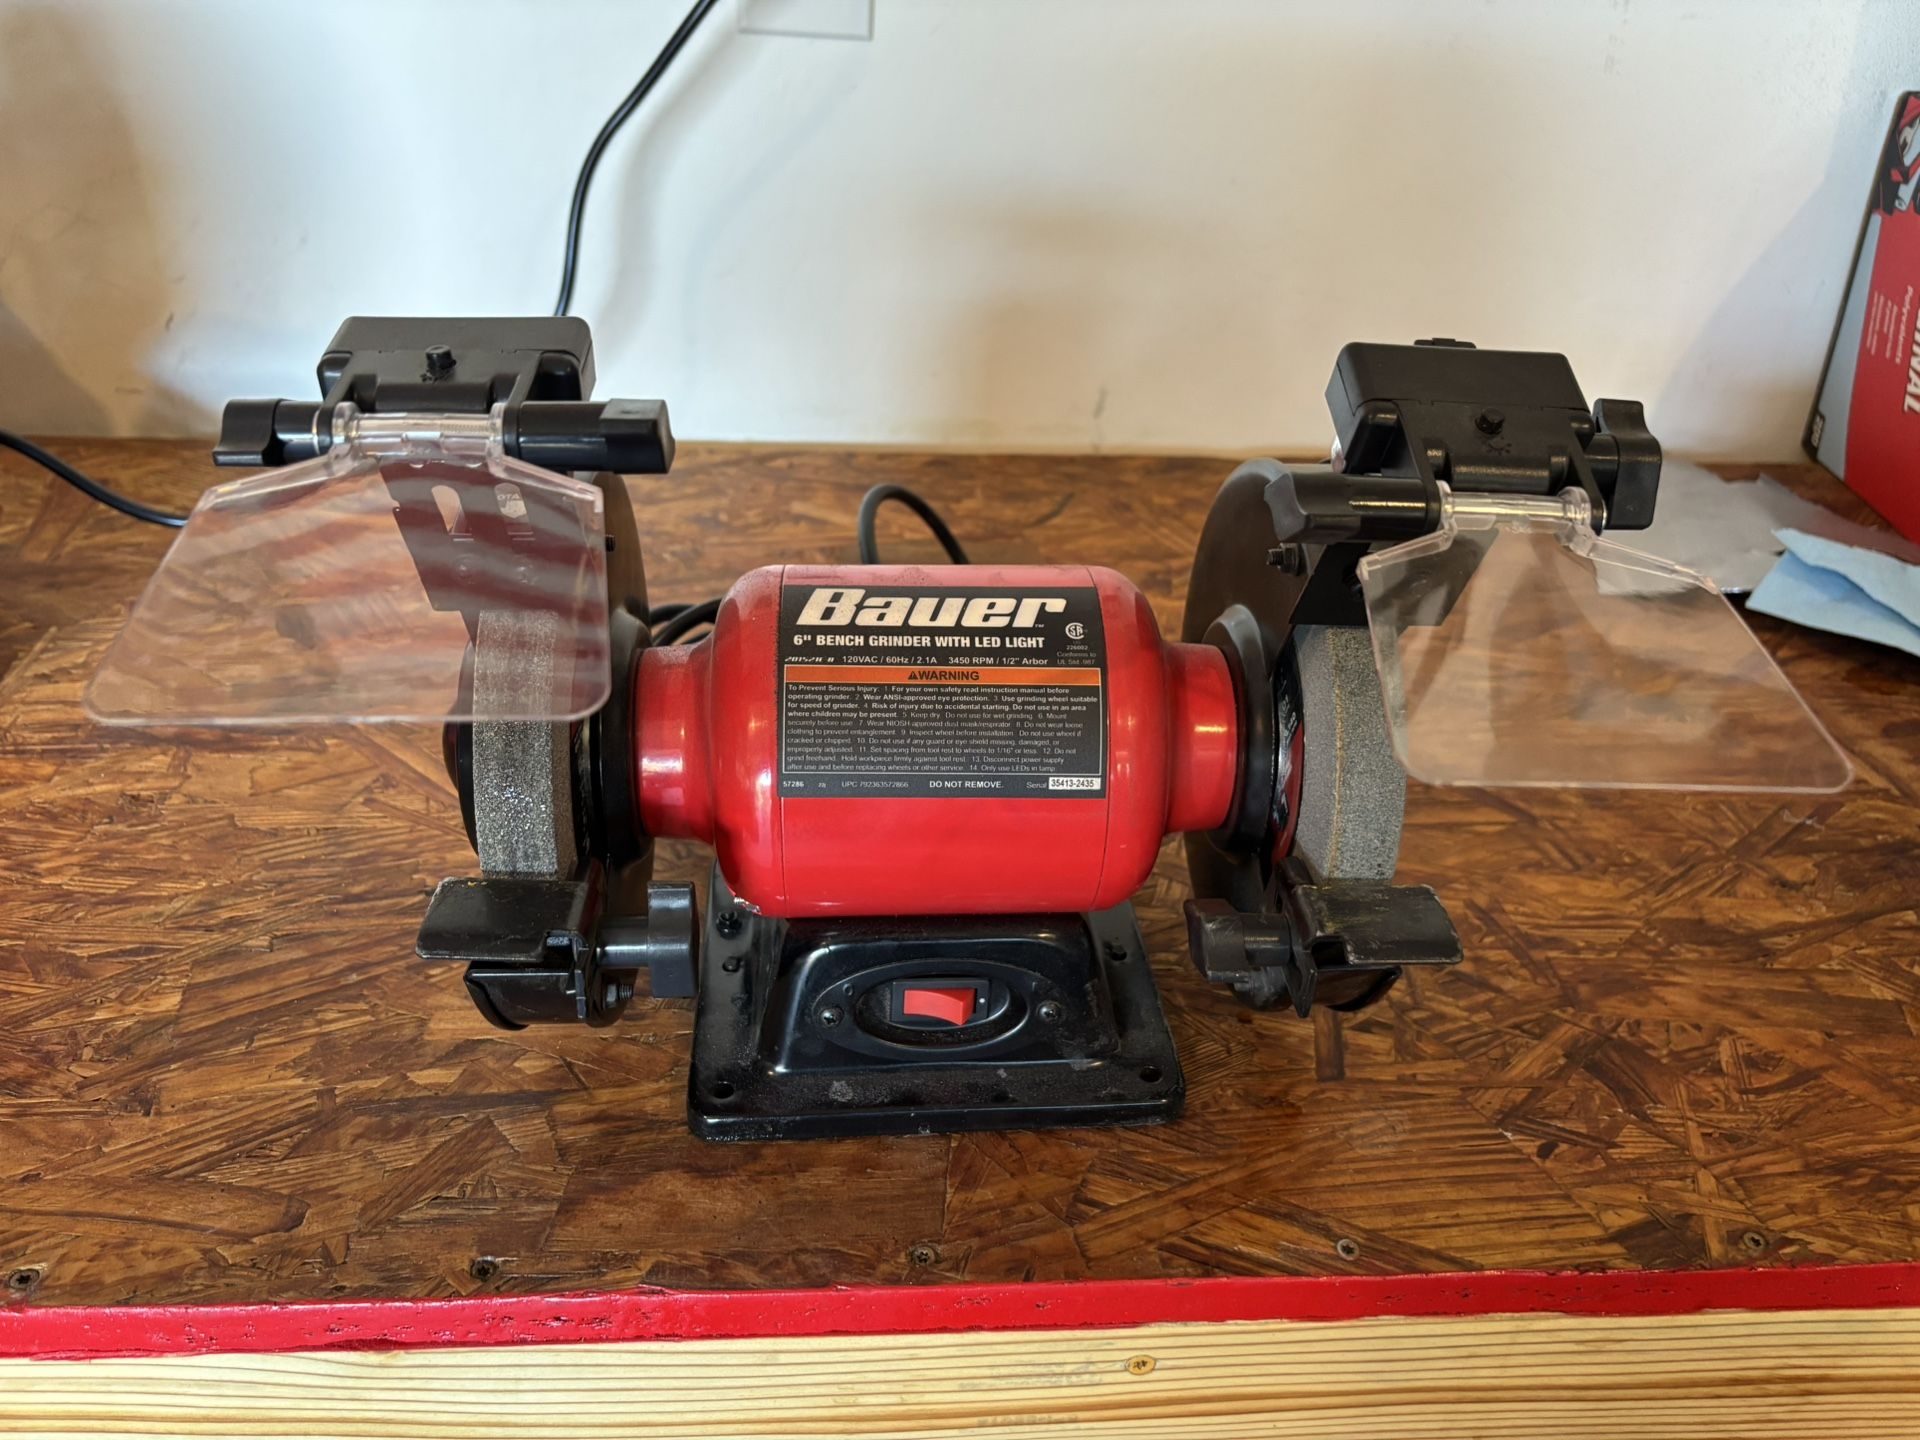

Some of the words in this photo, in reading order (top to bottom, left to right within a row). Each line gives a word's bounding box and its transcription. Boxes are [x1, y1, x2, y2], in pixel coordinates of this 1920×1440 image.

[796, 588, 1067, 628] Bauer
[793, 634, 811, 646] 6"
[816, 635, 865, 647] BENCH
[868, 635, 931, 647] GRINDER
[934, 636, 971, 647] WITH
[974, 636, 1001, 648] LED
[1005, 636, 1045, 648] LIGHT
[842, 655, 878, 663] 120VAC
[886, 656, 909, 664] 60Hz
[917, 656, 937, 664] 2.1A
[948, 656, 970, 665] 3450
[972, 656, 994, 665] RPM
[1022, 657, 1048, 665] Arbor
[919, 671, 980, 681] WARNING
[941, 686, 961, 694] safety
[788, 693, 822, 701] operating
[883, 694, 936, 702] ANSI-approved
[1017, 695, 1046, 703] grinding
[800, 702, 821, 710] speed
[899, 702, 919, 710] injury
[929, 780, 942, 788] DO
[965, 781, 1004, 789] REMOVE.
[1051, 779, 1094, 787] 35413-2435
